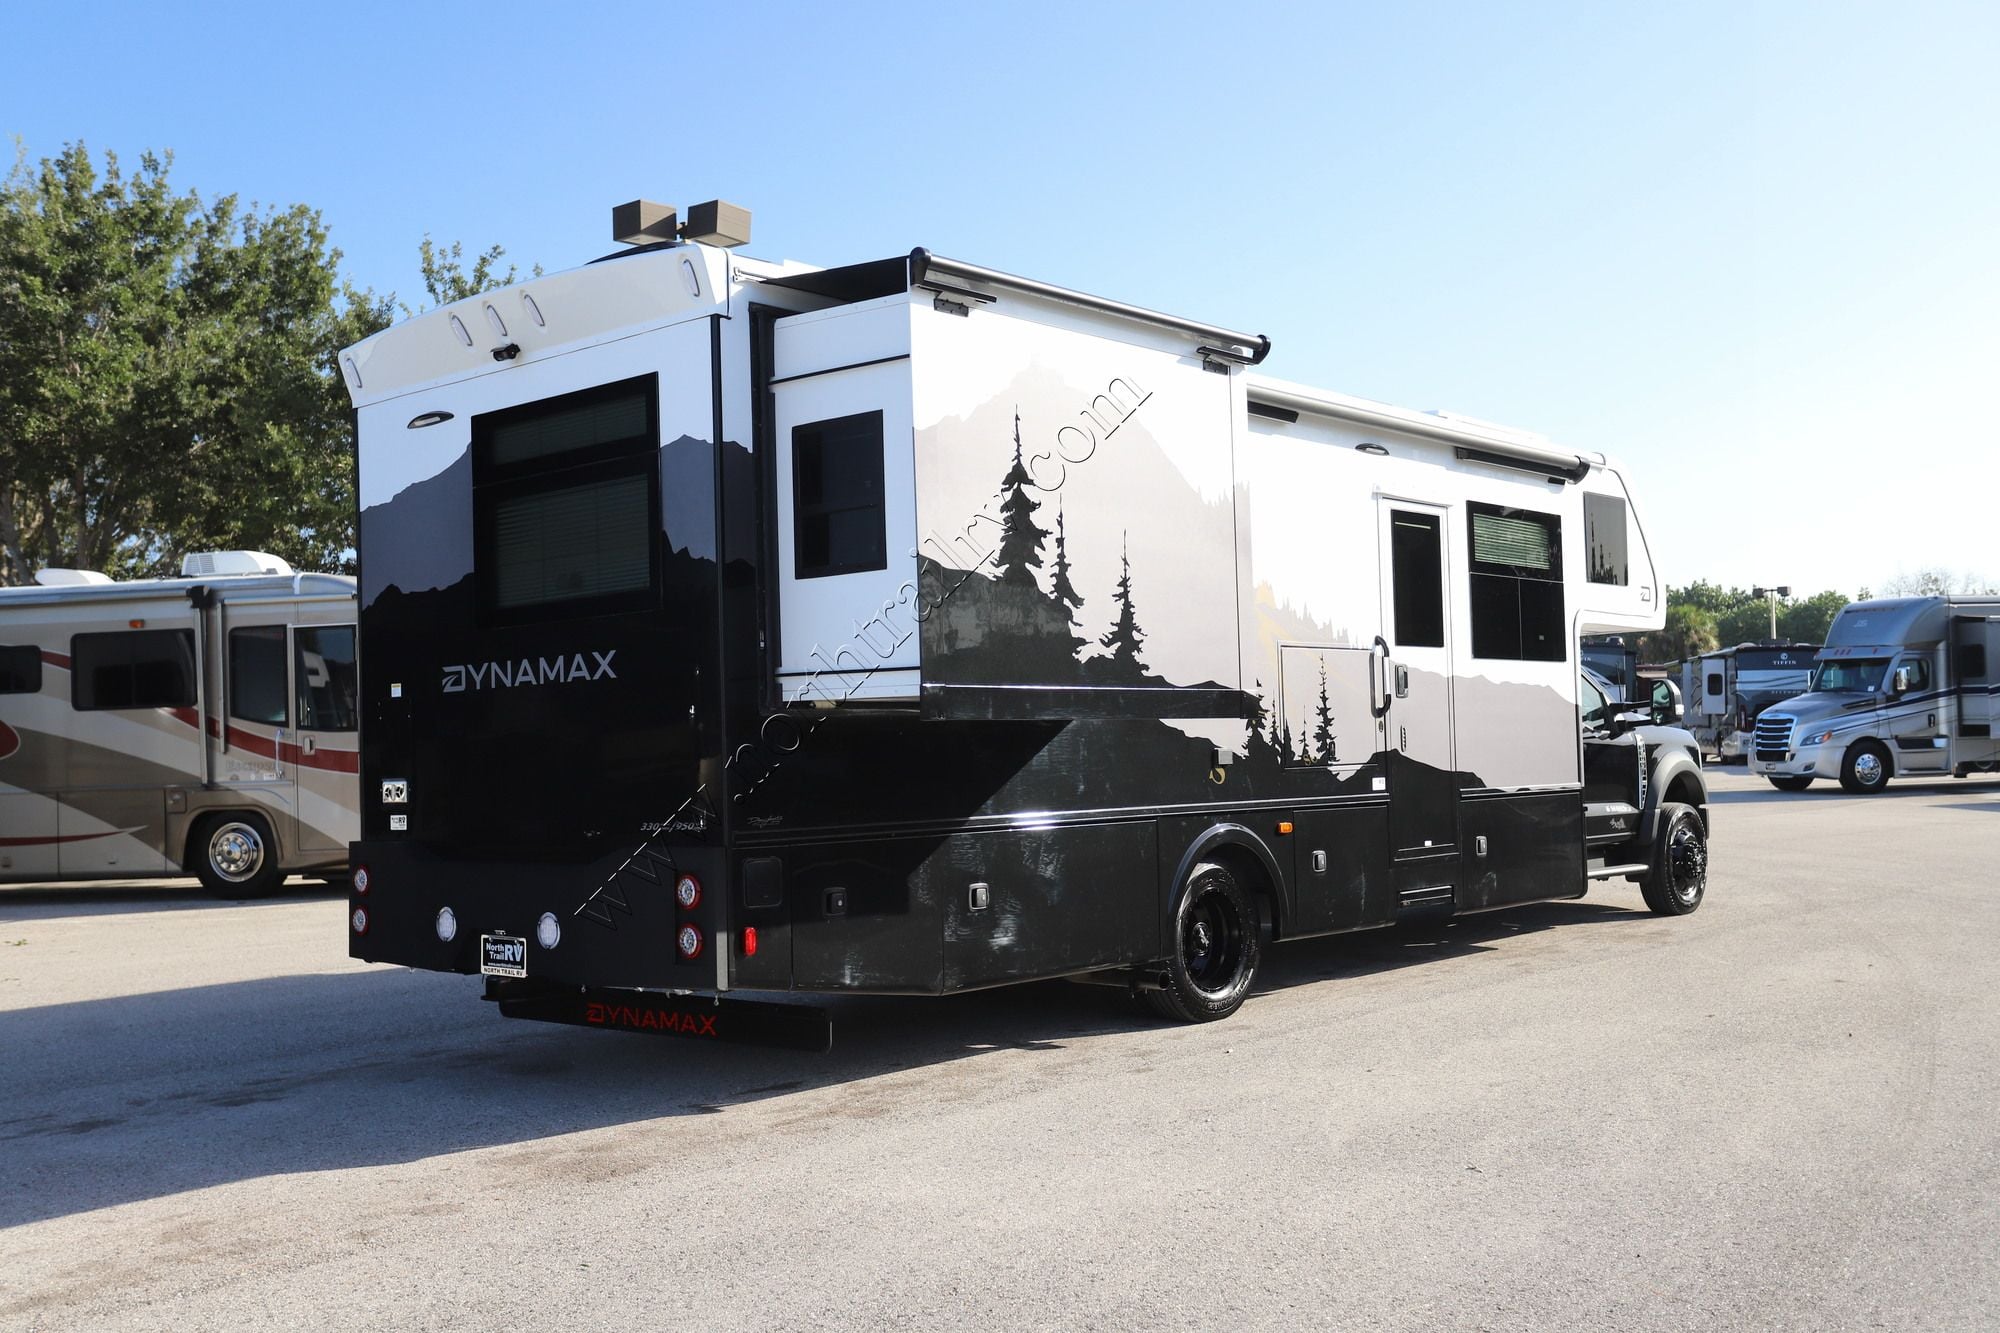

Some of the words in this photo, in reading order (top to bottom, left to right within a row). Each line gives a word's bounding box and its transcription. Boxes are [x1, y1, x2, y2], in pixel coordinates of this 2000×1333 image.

[441, 649, 618, 694] DYNAMAX
[486, 943, 504, 951] North
[489, 951, 504, 960] Trail
[504, 944, 523, 962] RV
[585, 1002, 719, 1039] DYNAMAX
